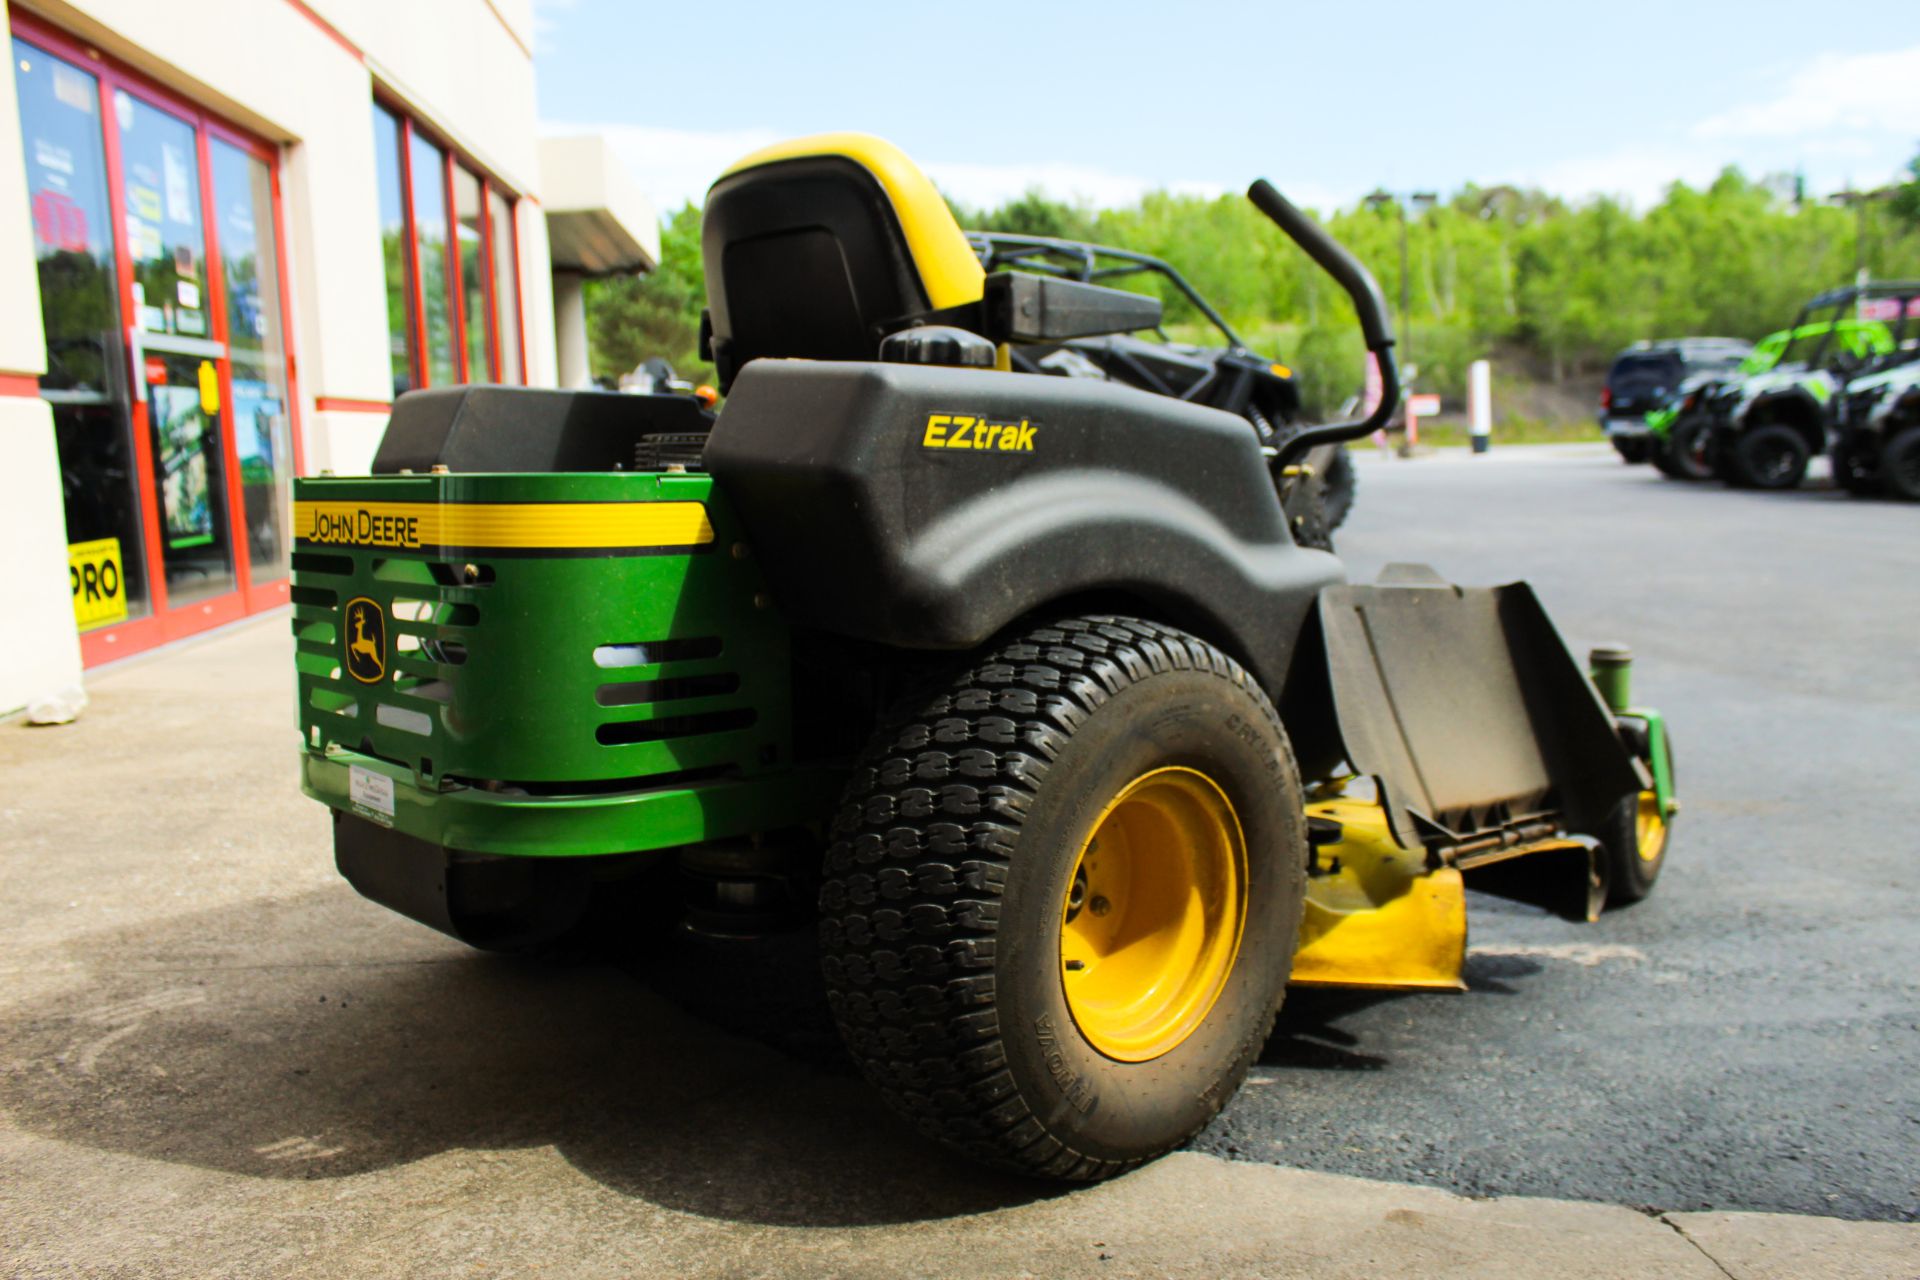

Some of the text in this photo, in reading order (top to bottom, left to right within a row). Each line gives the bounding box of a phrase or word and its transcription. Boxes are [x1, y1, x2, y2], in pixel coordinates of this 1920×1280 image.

[923, 415, 1038, 451] EZtrak
[309, 508, 419, 543] JOHN DEERE
[1034, 1011, 1093, 1113] INNOVA
